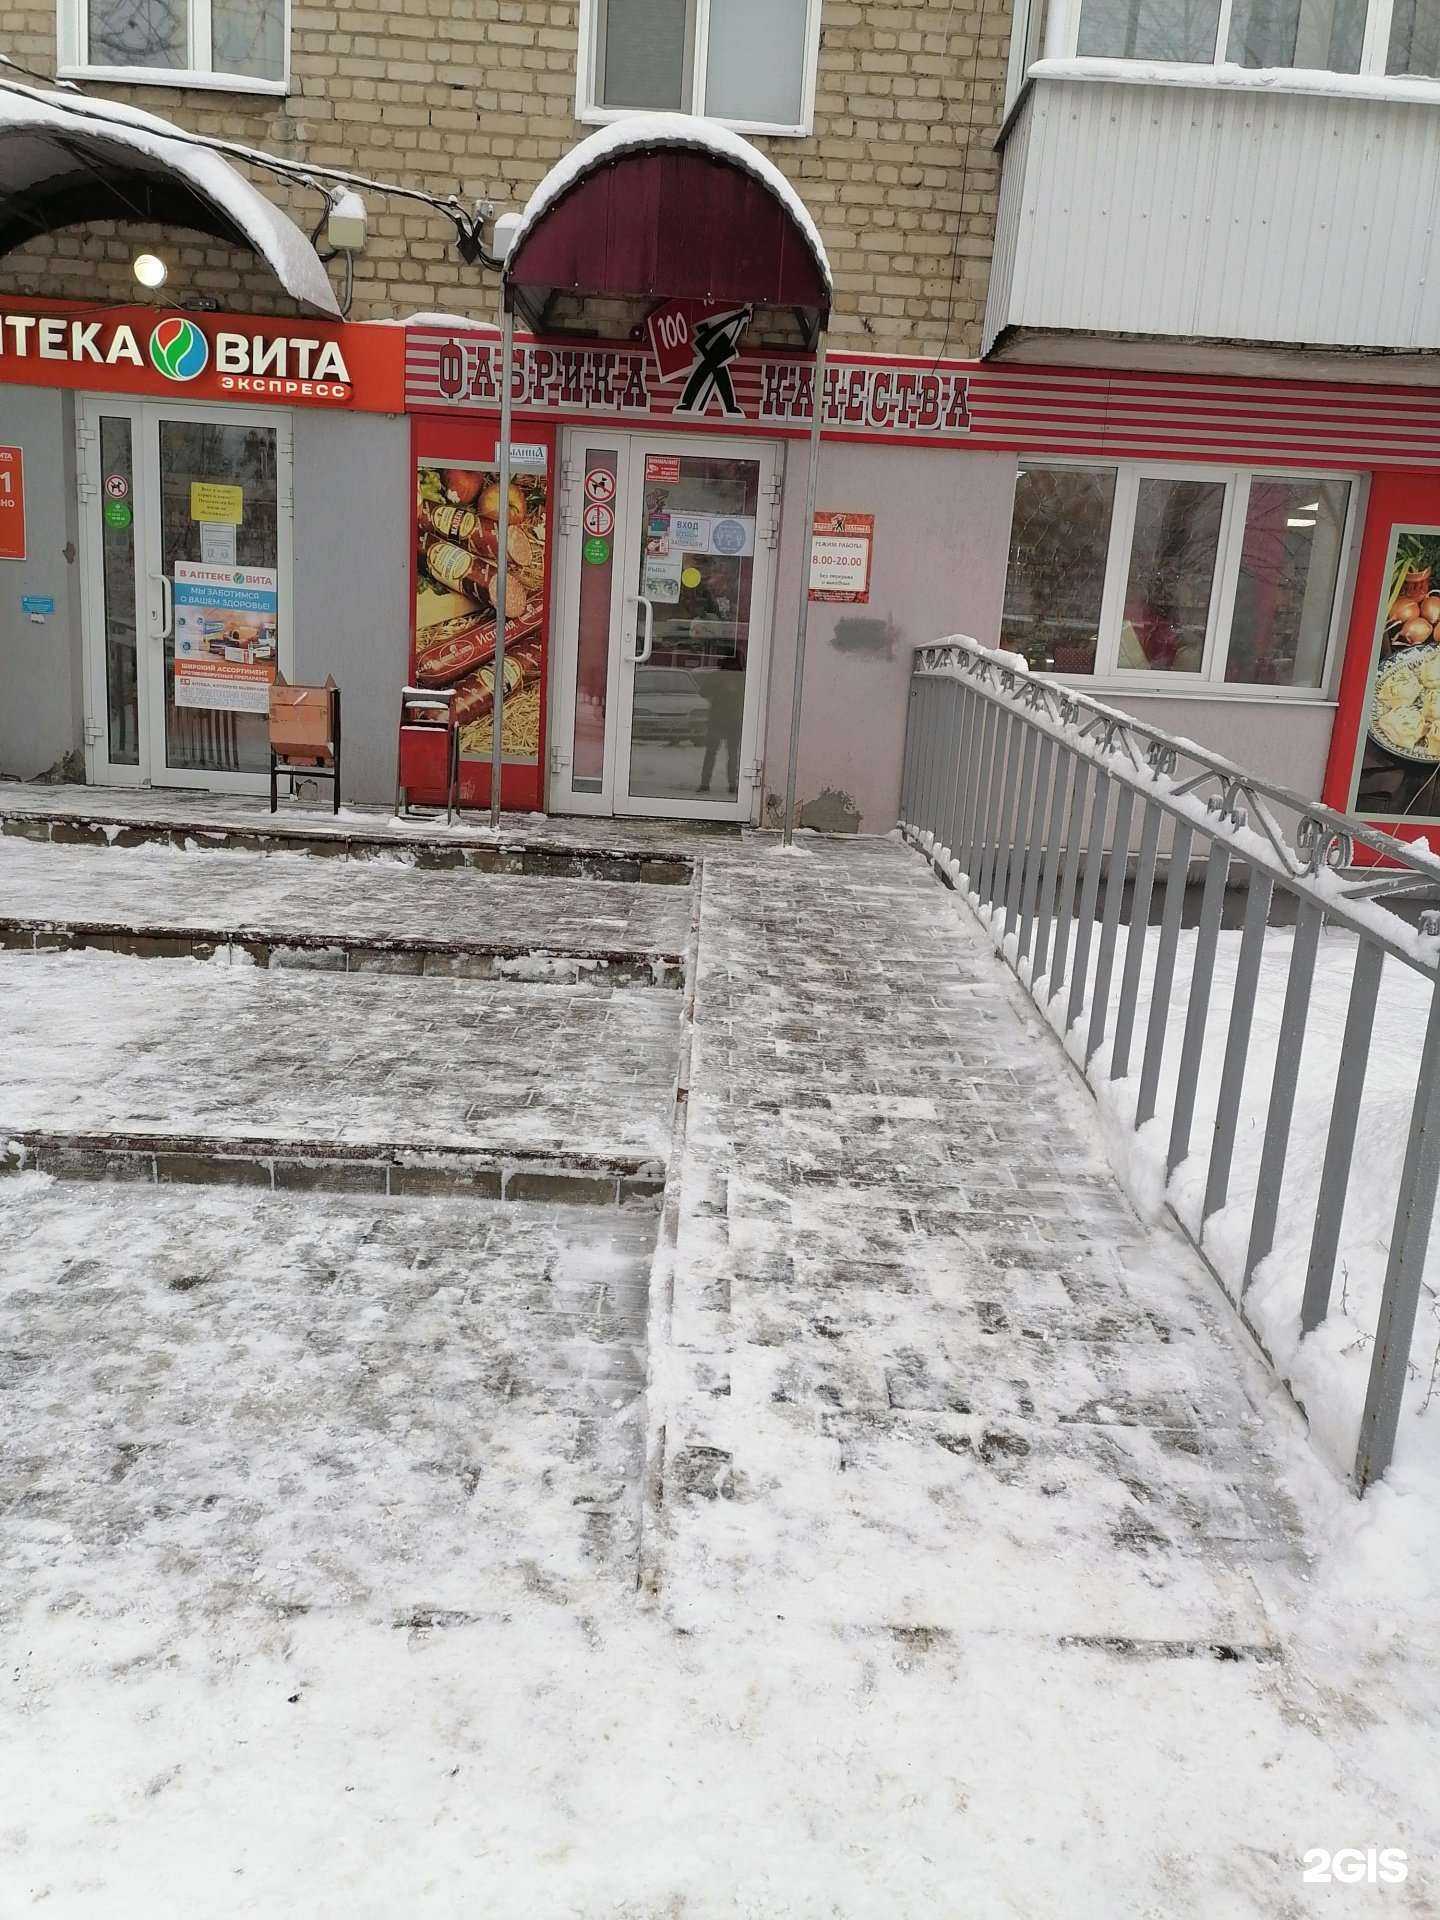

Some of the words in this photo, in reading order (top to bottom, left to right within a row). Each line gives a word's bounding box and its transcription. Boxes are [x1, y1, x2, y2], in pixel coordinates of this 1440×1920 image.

[658, 312, 688, 350] 100
[0, 314, 144, 367] ТЕКА
[216, 332, 351, 383] ВИТА
[221, 376, 345, 398] ЭКСПРЕСС
[439, 338, 651, 412] ФАБРИКА
[759, 363, 973, 433] КАЧЕСТВА
[676, 520, 699, 530] ВХОД
[812, 555, 862, 567] 8.00-20.00
[179, 569, 188, 578] В
[190, 571, 231, 582] АПТЕКЕ
[245, 575, 273, 586] ВИТА
[189, 596, 220, 605] ВАШЕМ
[191, 586, 206, 595] МЫ
[207, 588, 260, 600] ЗАБОТИМСЯ
[181, 663, 216, 672] ШИРОКИЙ
[216, 666, 268, 677] АССОРТИМЕНТ
